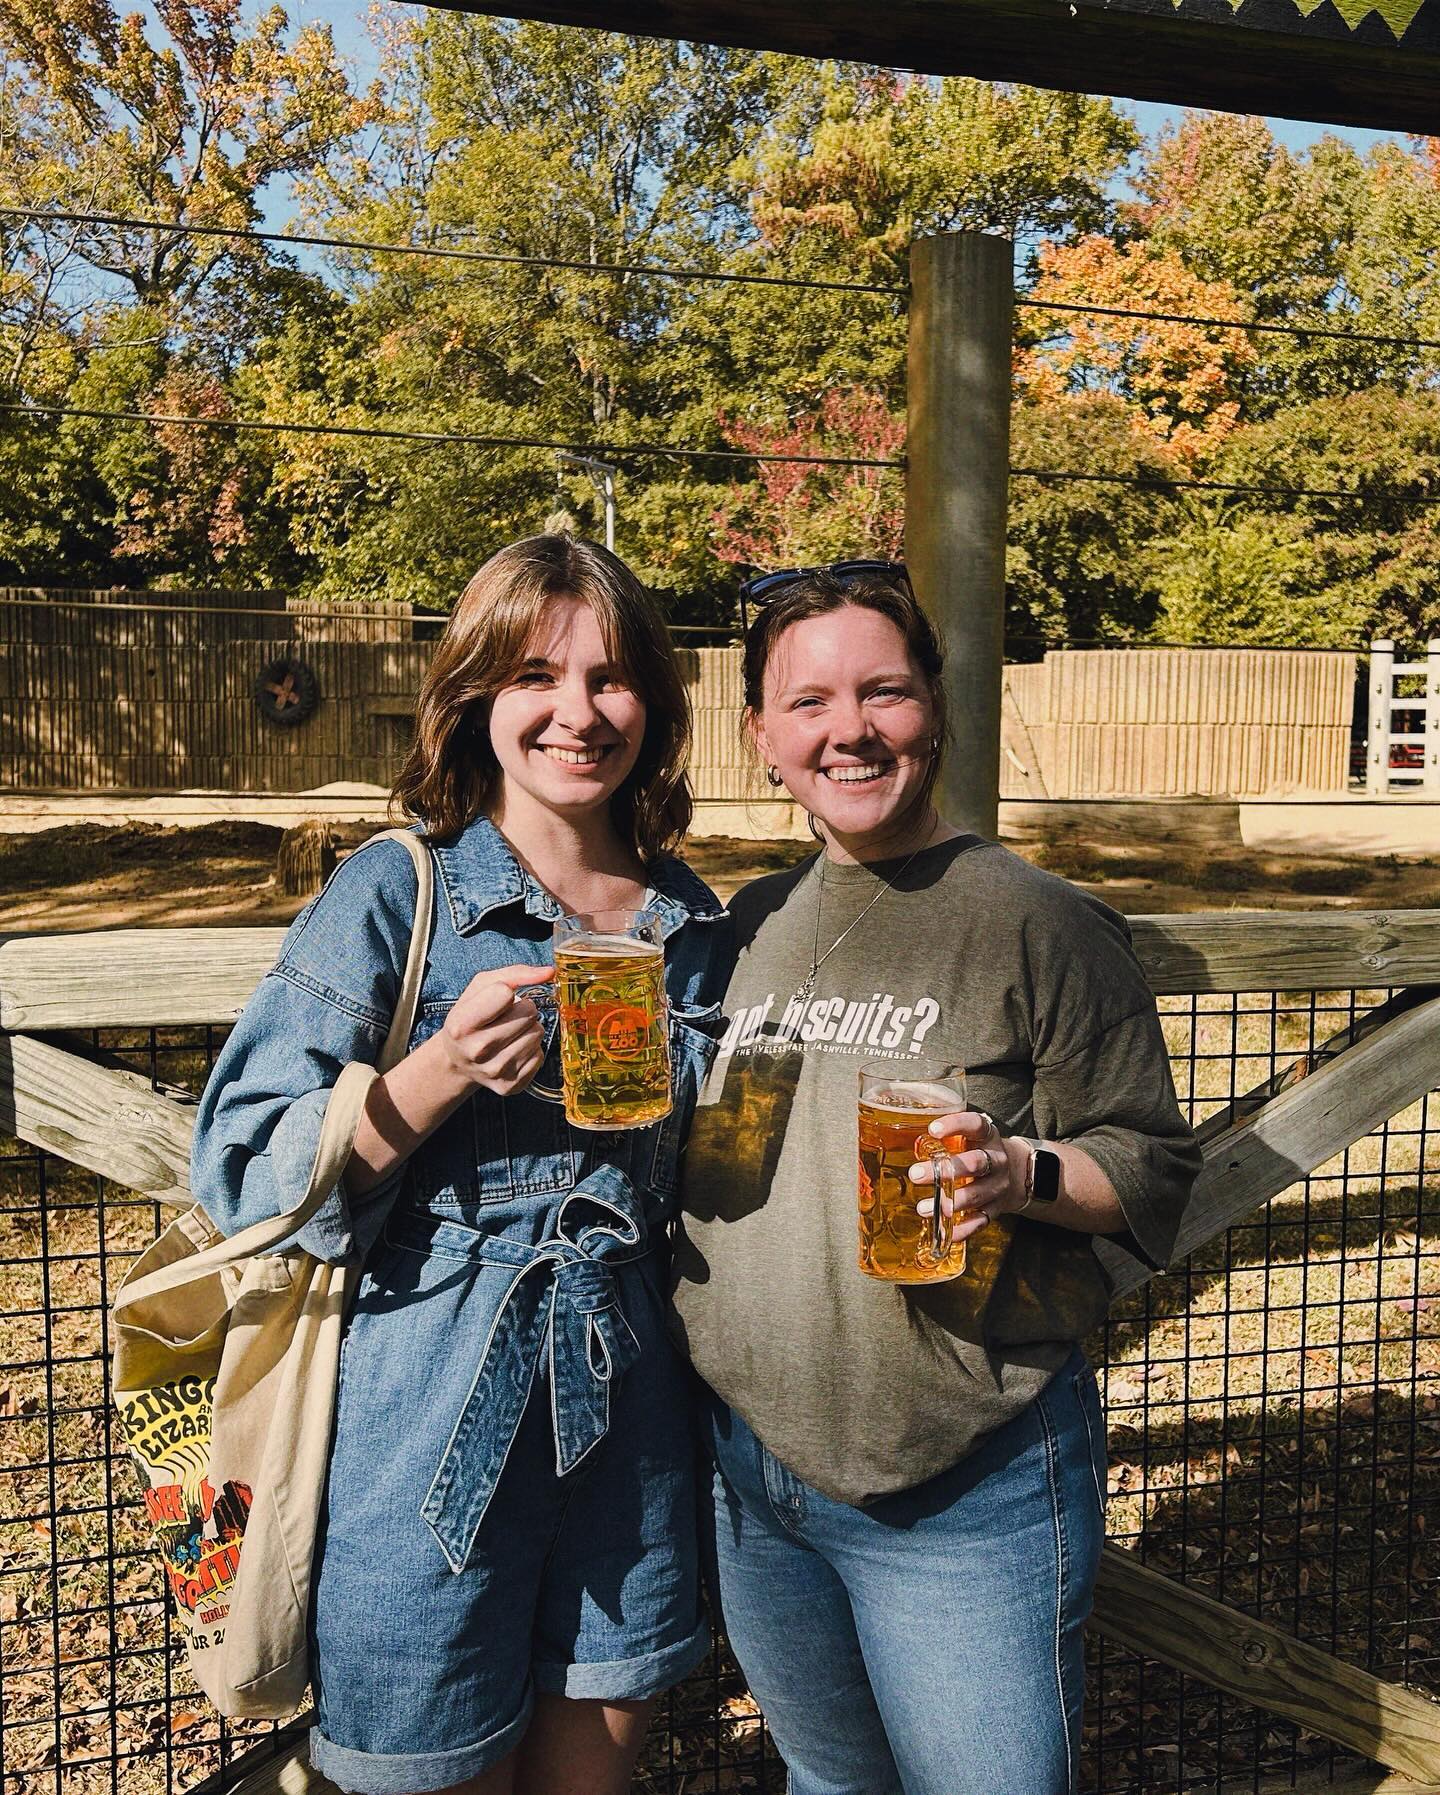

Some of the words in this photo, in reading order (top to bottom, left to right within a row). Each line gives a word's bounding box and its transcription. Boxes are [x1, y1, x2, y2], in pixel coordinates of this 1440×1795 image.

[717, 993, 775, 1059] got
[774, 992, 941, 1054] biscuits?
[736, 1048, 751, 1057] THE
[140, 1414, 213, 1460] LIZAR
